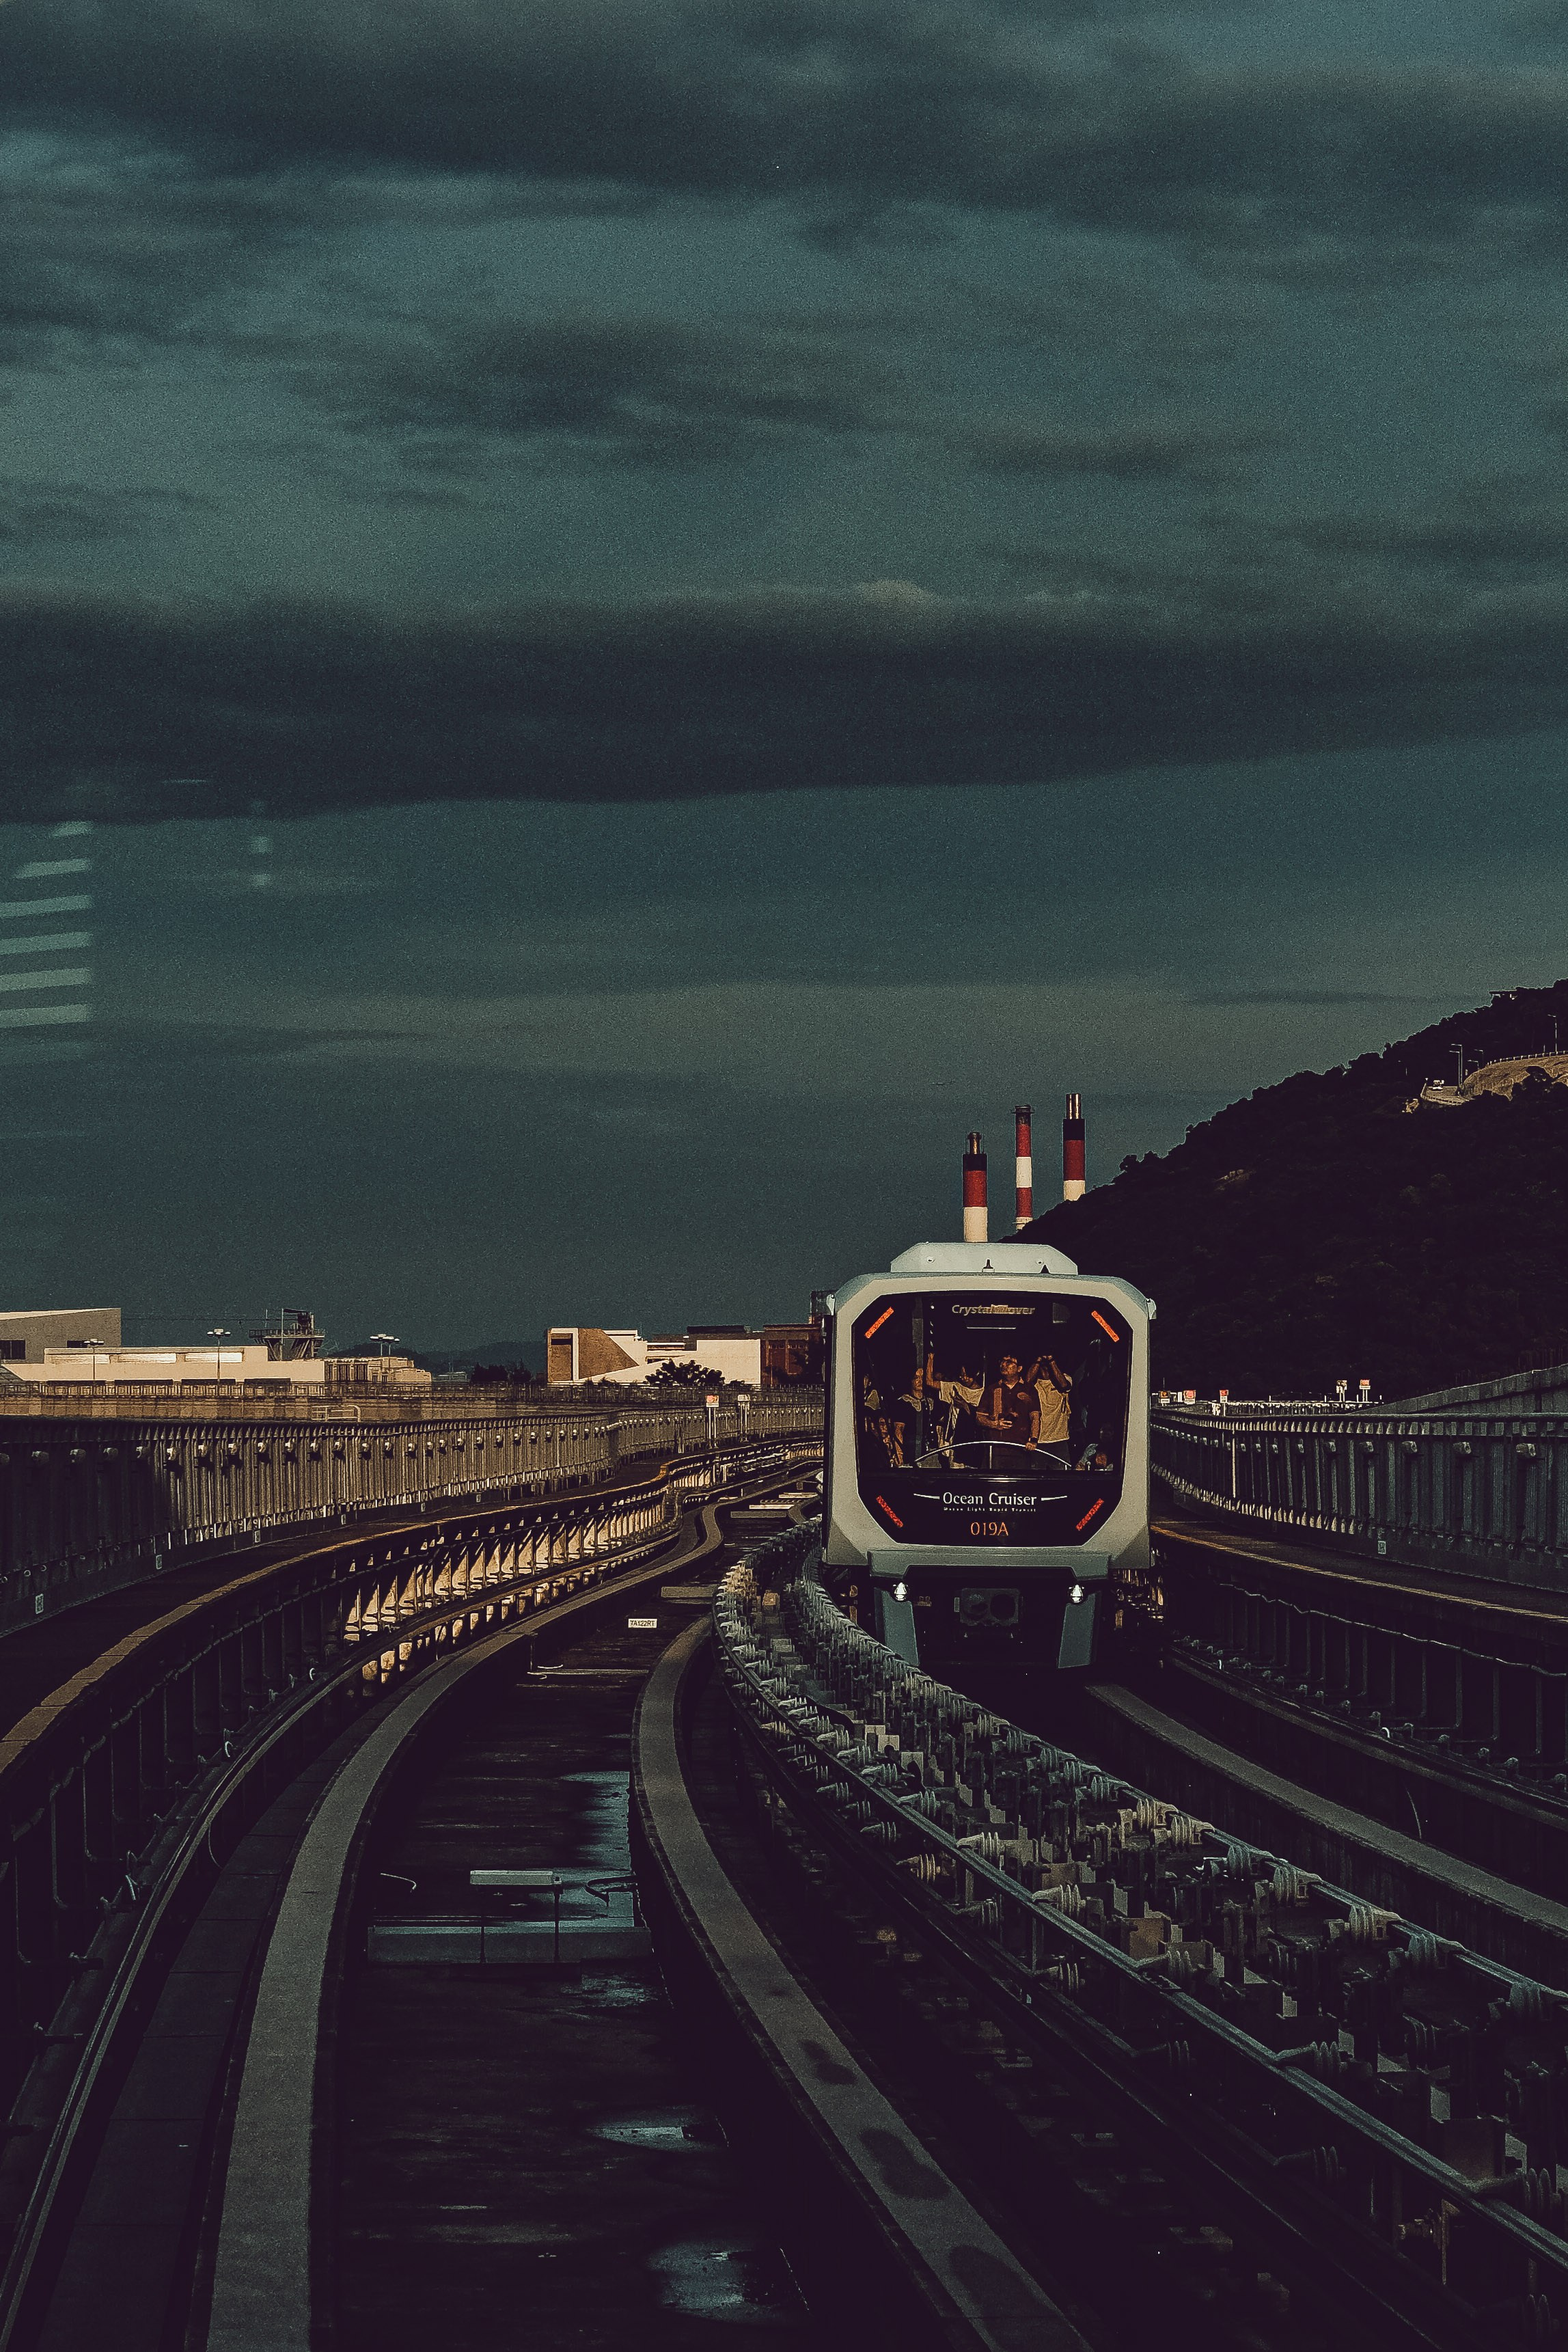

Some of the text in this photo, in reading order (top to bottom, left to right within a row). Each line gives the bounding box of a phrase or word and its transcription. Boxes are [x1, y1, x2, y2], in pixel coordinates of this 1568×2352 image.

[943, 1492, 1037, 1505] Ocean Cruiser
[970, 1522, 1008, 1536] 019A
